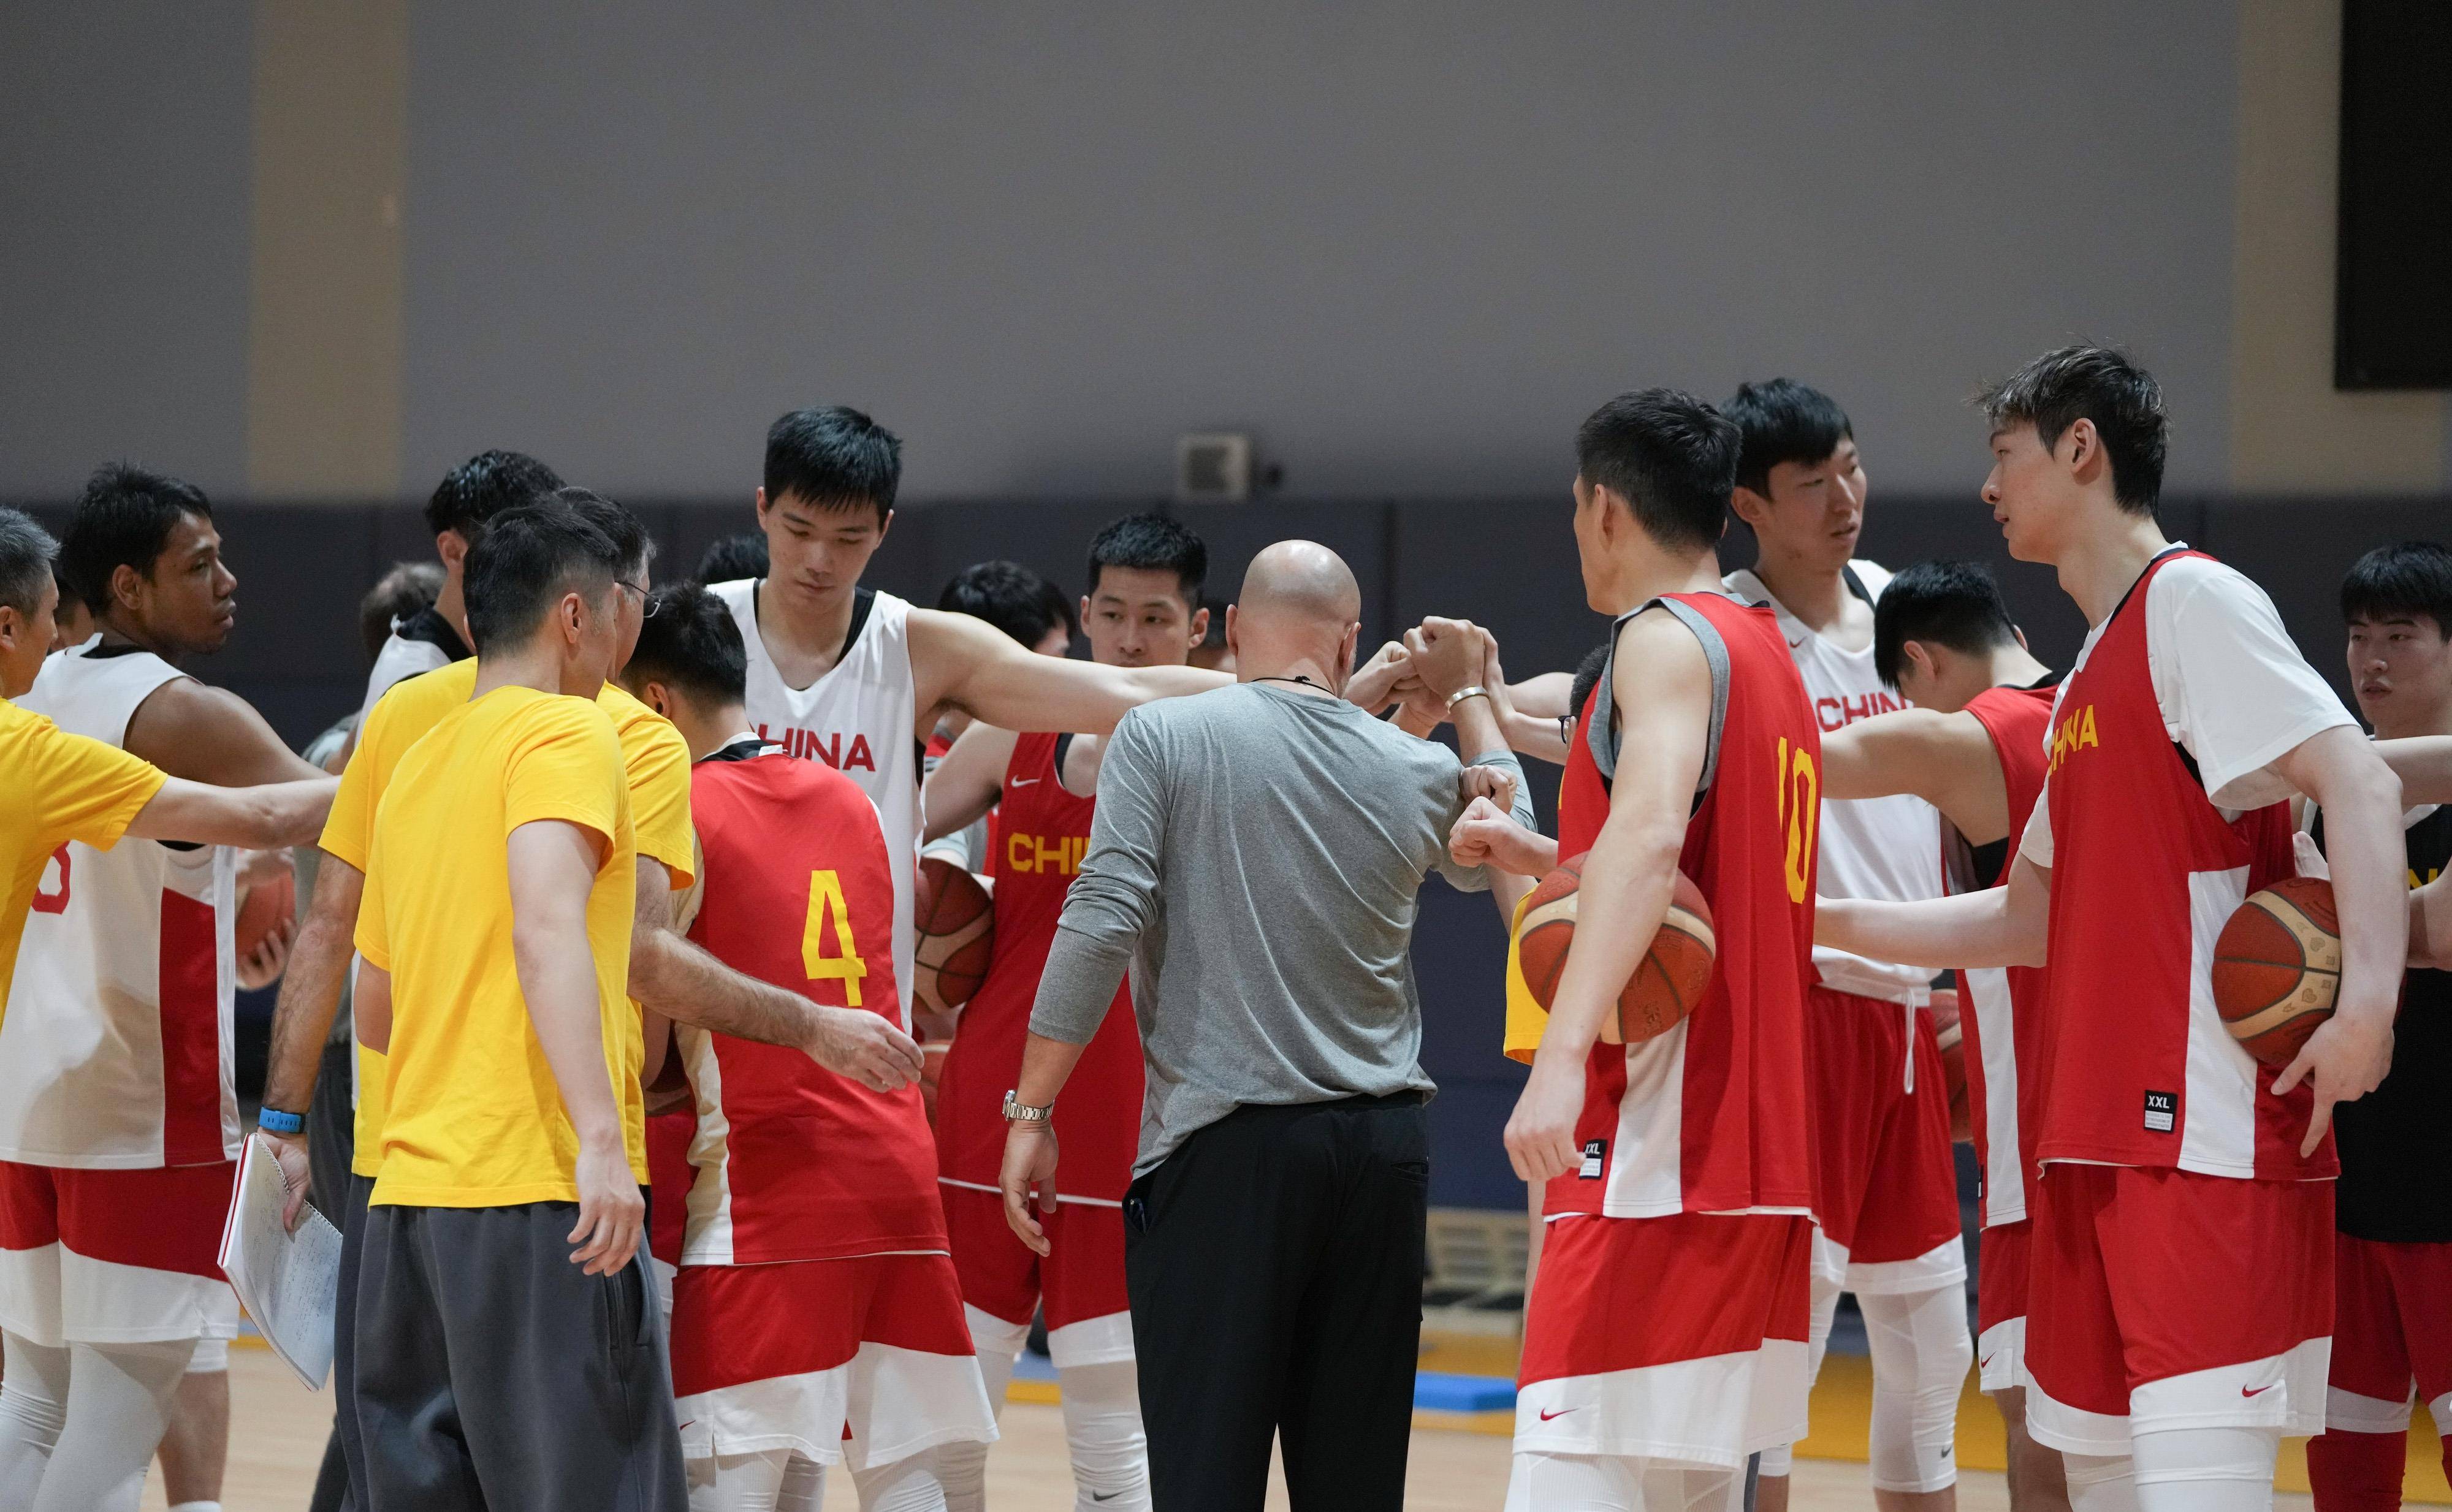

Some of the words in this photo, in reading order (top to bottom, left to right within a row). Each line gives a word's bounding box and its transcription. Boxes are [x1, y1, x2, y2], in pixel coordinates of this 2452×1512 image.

[748, 723, 876, 772] HINA
[1778, 736, 1816, 904] 10
[1008, 832, 1091, 875] CHI
[801, 869, 867, 1006] 4
[2148, 1095, 2170, 1109] XXL
[1584, 1142, 1601, 1155] XXL
